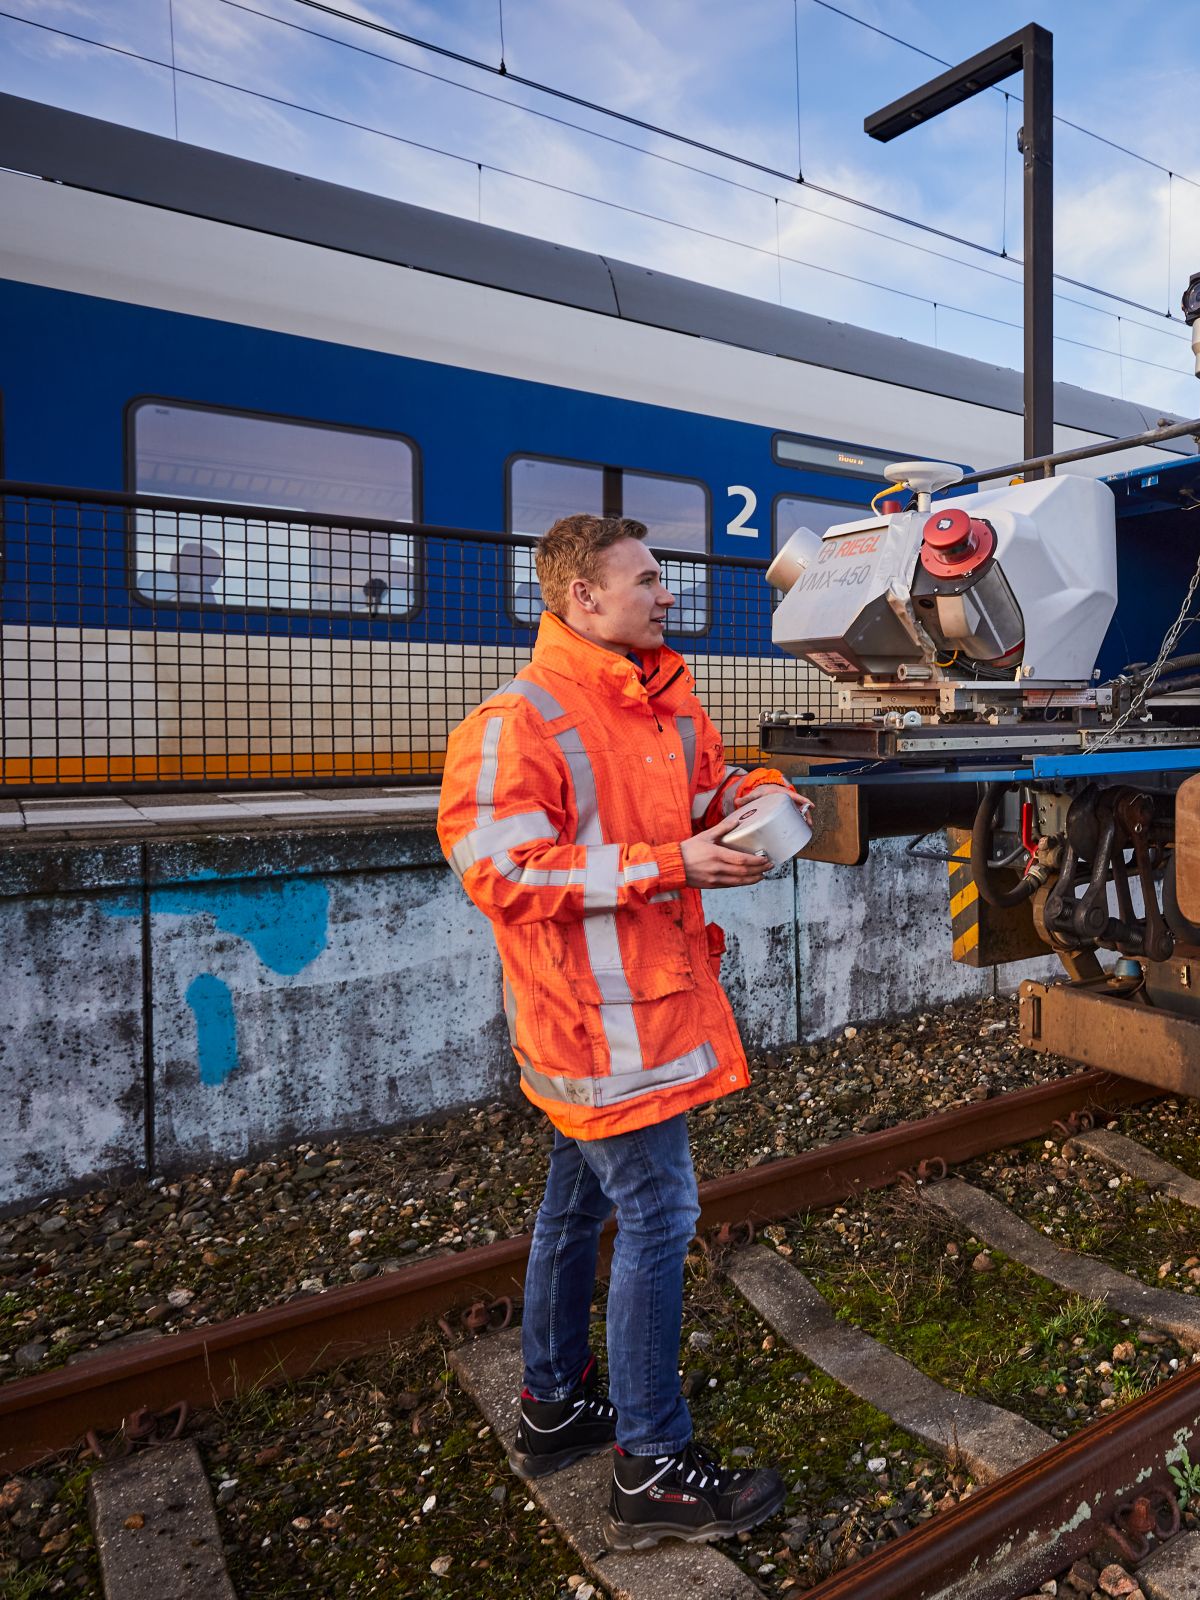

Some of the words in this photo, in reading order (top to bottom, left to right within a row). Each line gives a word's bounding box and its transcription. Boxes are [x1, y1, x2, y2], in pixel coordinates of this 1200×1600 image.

[727, 485, 759, 538] 2
[836, 535, 880, 557] RIEGL
[800, 565, 870, 591] VMX-450
